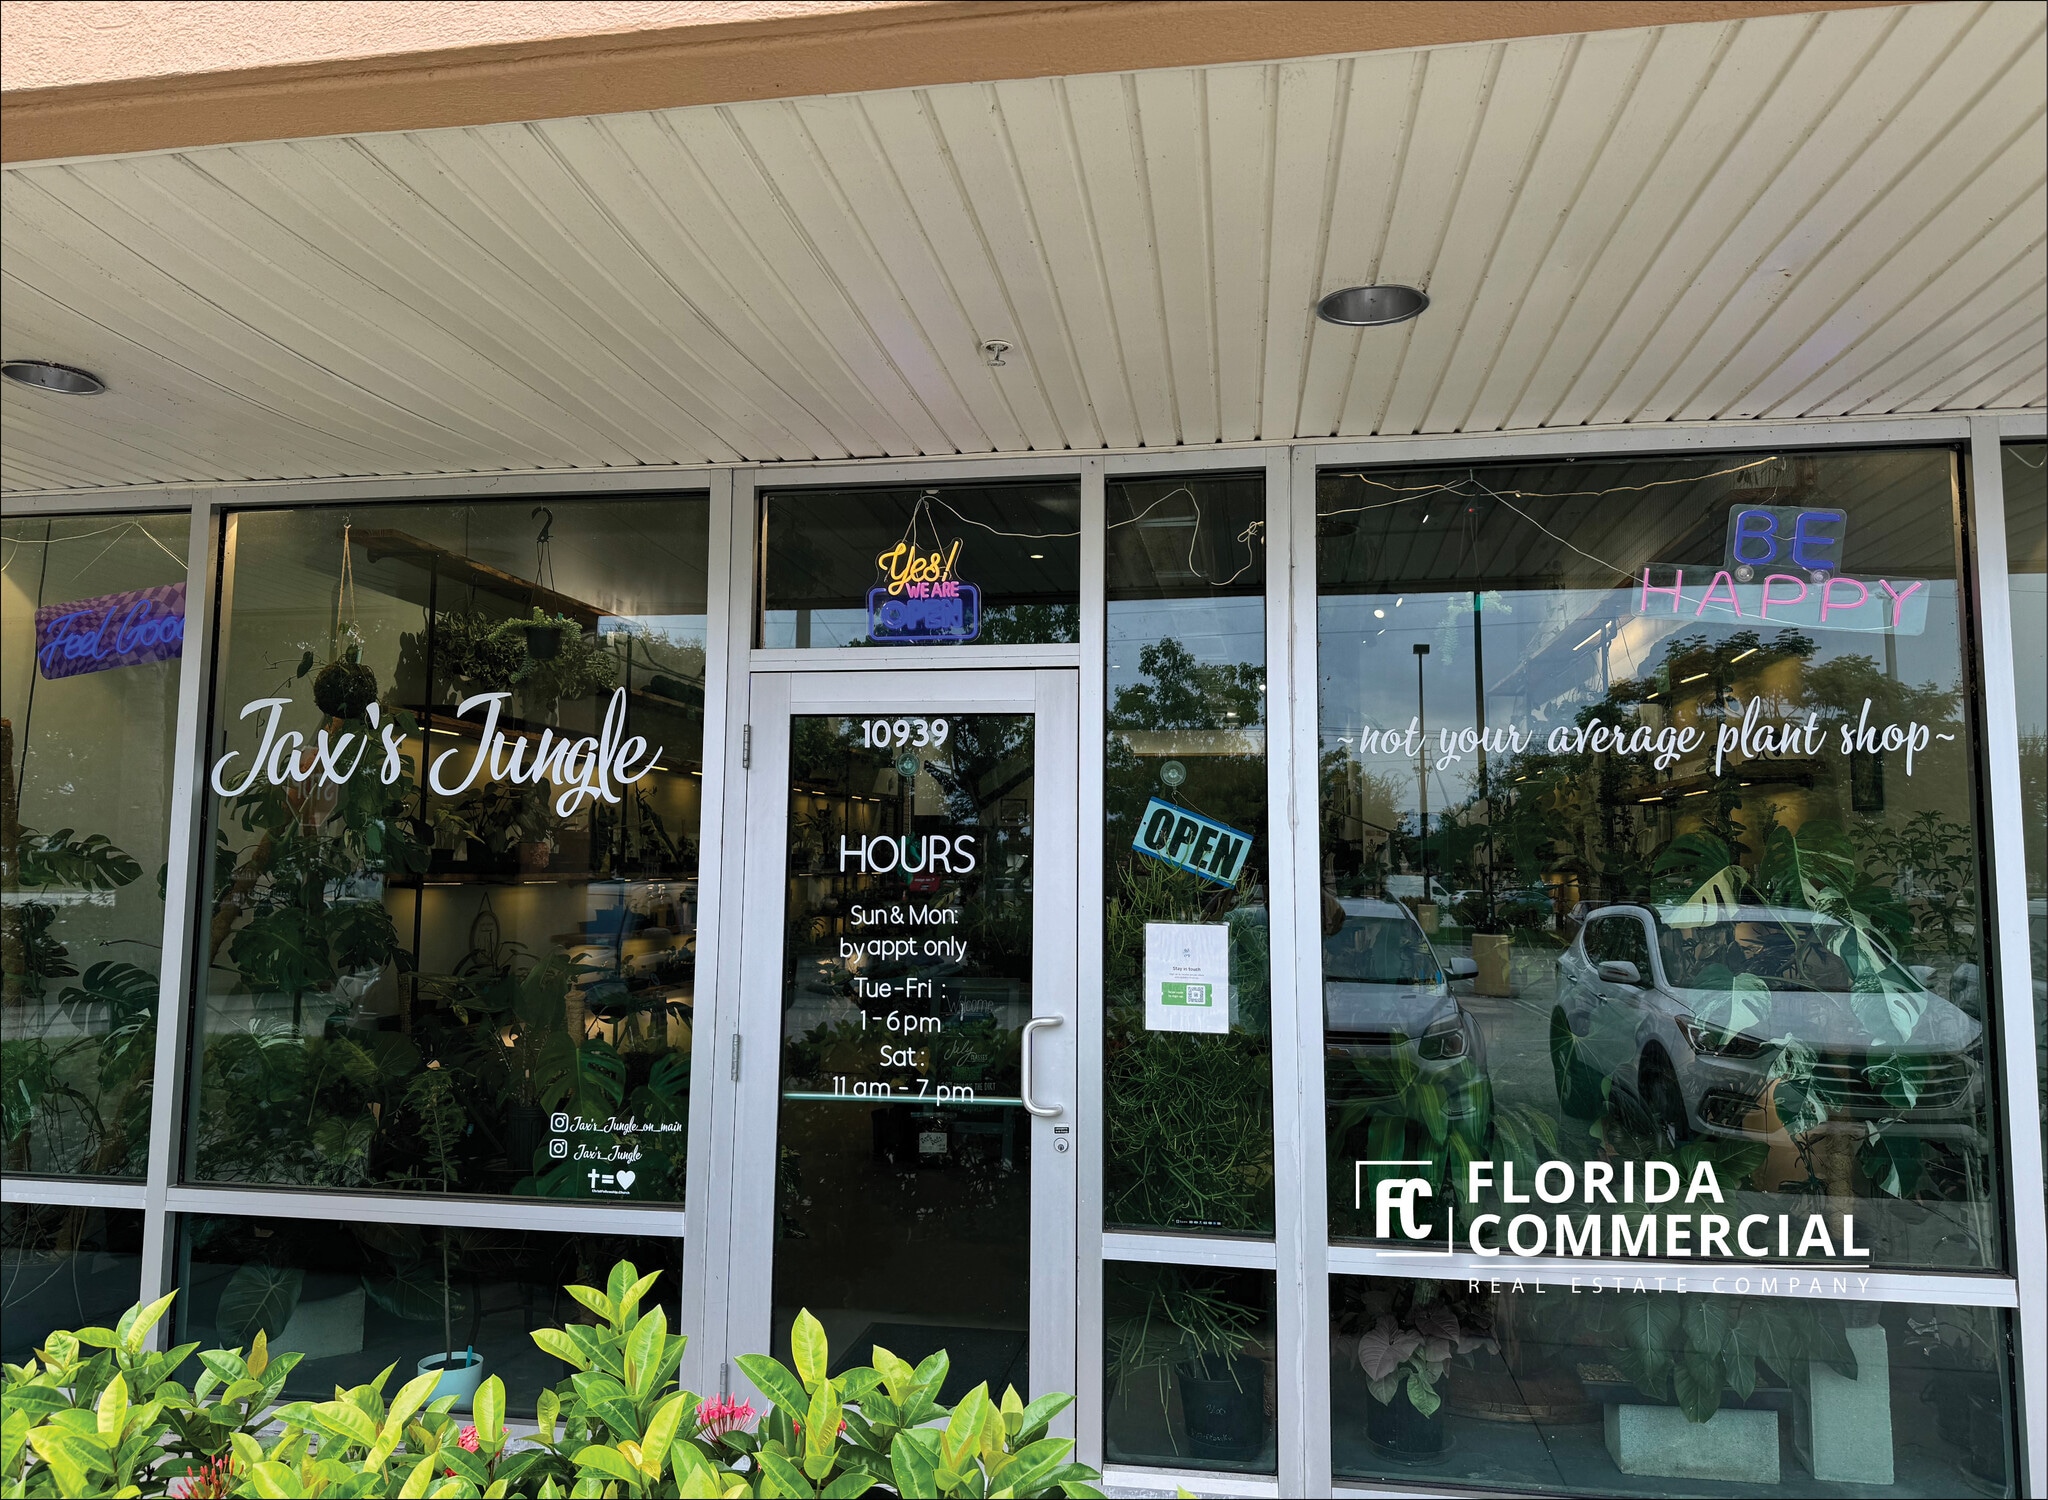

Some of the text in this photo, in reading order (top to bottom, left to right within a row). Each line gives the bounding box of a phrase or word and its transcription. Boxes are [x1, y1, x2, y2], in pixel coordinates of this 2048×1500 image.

[1733, 510, 1840, 568] BE
[878, 541, 959, 596] Yes!
[906, 581, 960, 598] WE ARE
[880, 598, 964, 630] OPEN
[1640, 567, 1922, 627] HAPPY
[39, 605, 118, 669] Feel
[211, 686, 663, 818] Jax's Jungle
[861, 717, 949, 751] 10939
[1436, 724, 1533, 771] your
[1547, 718, 1705, 770] average
[1715, 695, 1828, 776] plant
[840, 834, 976, 873] HOURS
[1143, 808, 1244, 879] OPEN
[839, 935, 967, 964] by appt only
[879, 1044, 925, 1067] Sat:
[832, 1075, 846, 1096] 11
[853, 1081, 891, 1098] am
[916, 1078, 929, 1100] 7
[936, 1085, 974, 1107] pm
